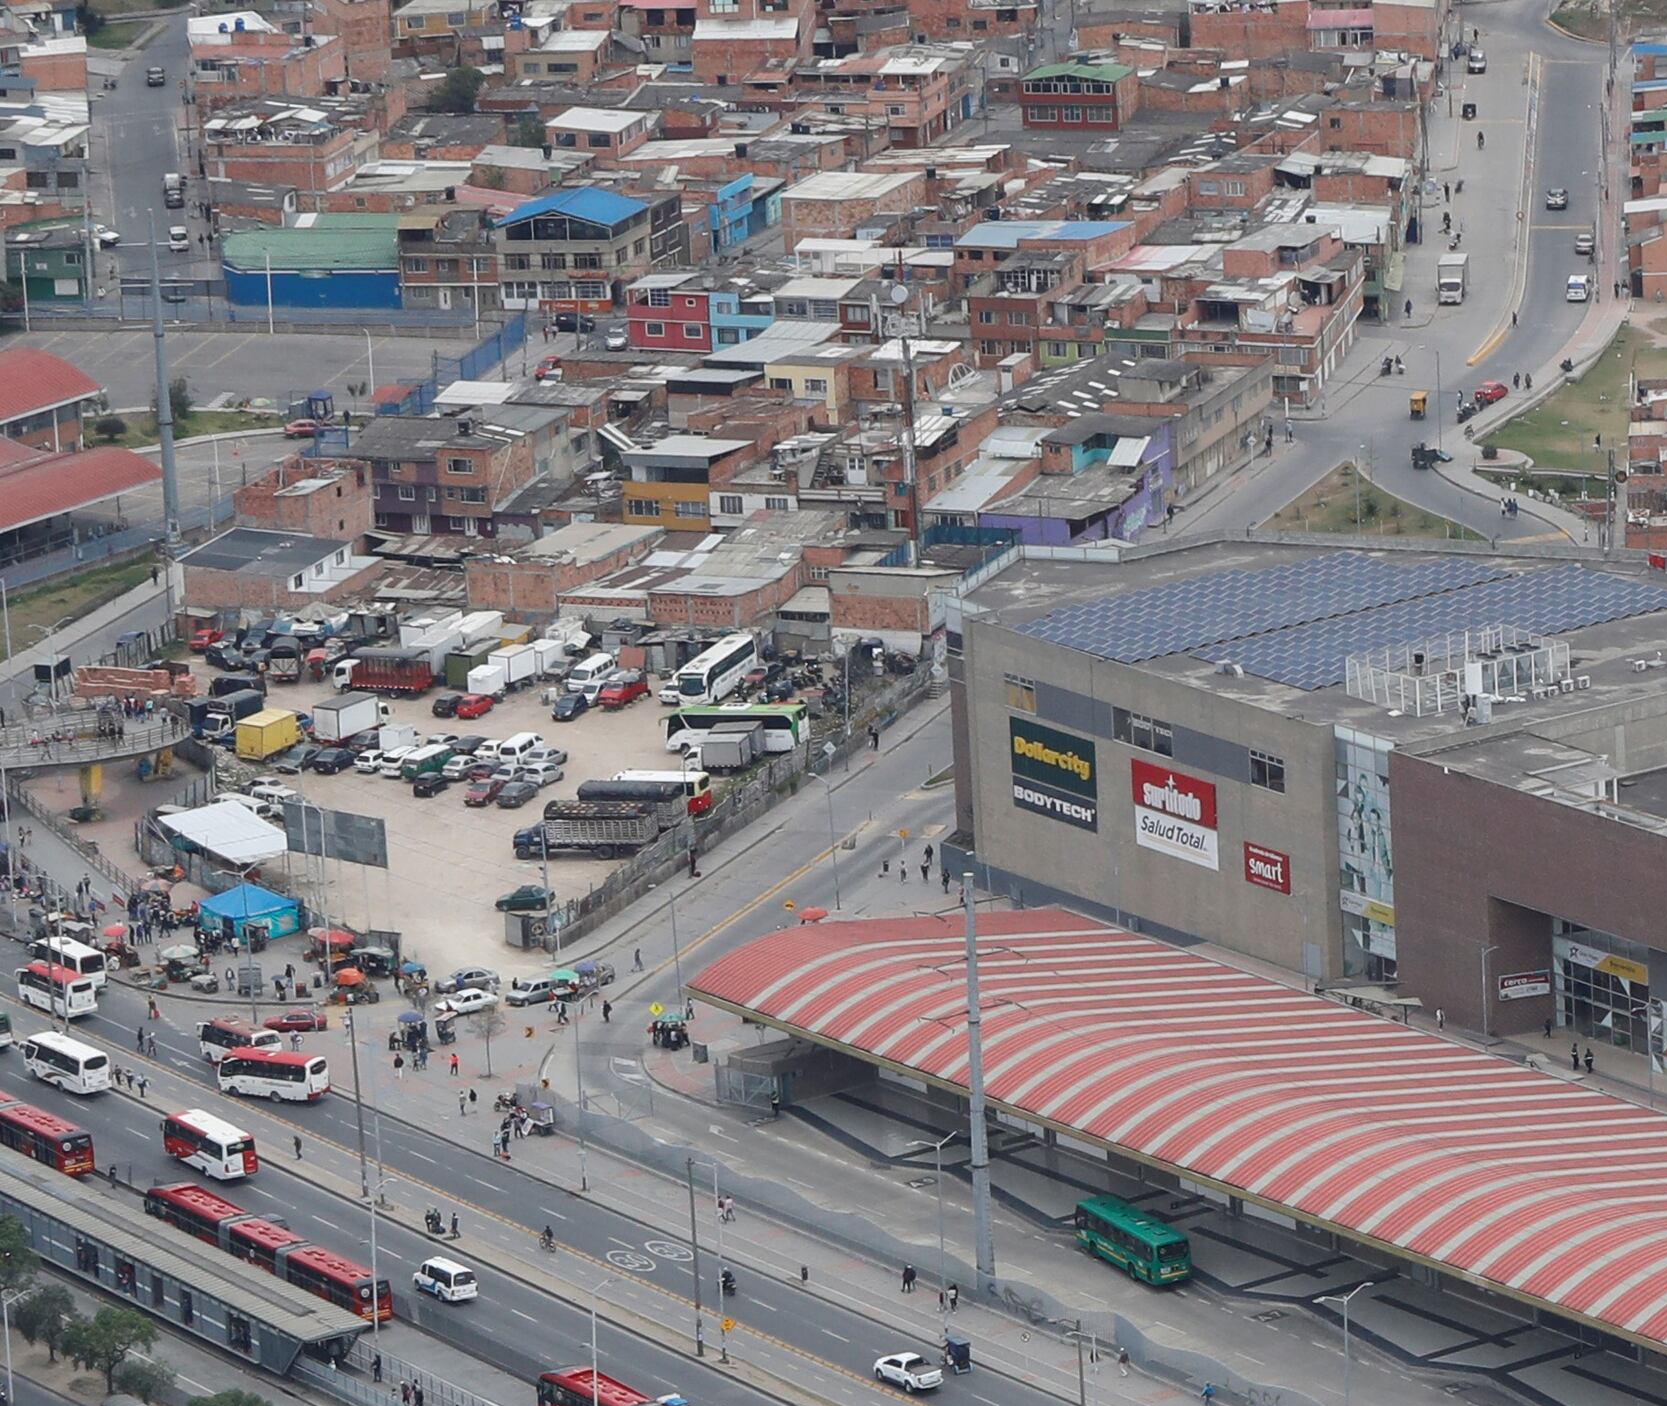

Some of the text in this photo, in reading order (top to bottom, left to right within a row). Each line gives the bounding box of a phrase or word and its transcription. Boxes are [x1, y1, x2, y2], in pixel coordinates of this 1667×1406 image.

[1014, 736, 1090, 781] Dollarcity
[1013, 785, 1093, 823] BODYTECH
[1248, 857, 1284, 883] smart
